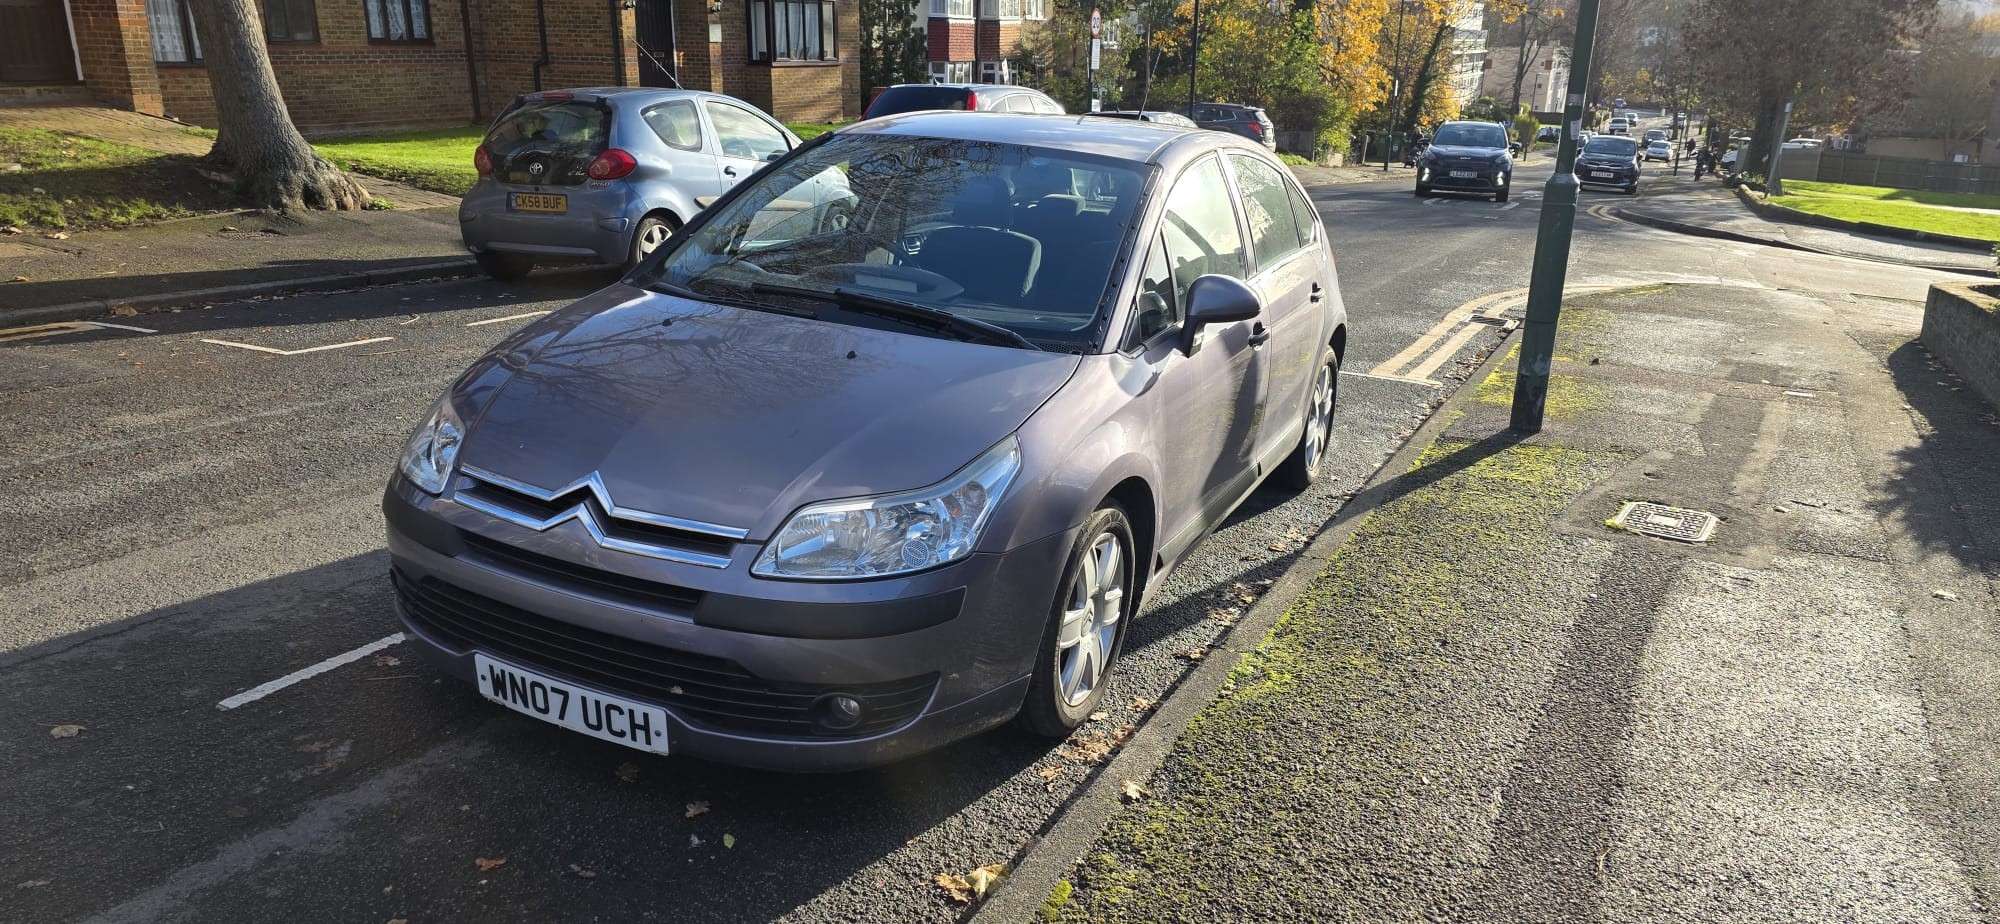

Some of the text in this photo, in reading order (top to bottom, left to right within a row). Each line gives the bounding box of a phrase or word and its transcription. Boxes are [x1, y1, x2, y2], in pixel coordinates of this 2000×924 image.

[515, 195, 562, 209] CK58 BUF
[488, 664, 652, 746] WN07 UCH
